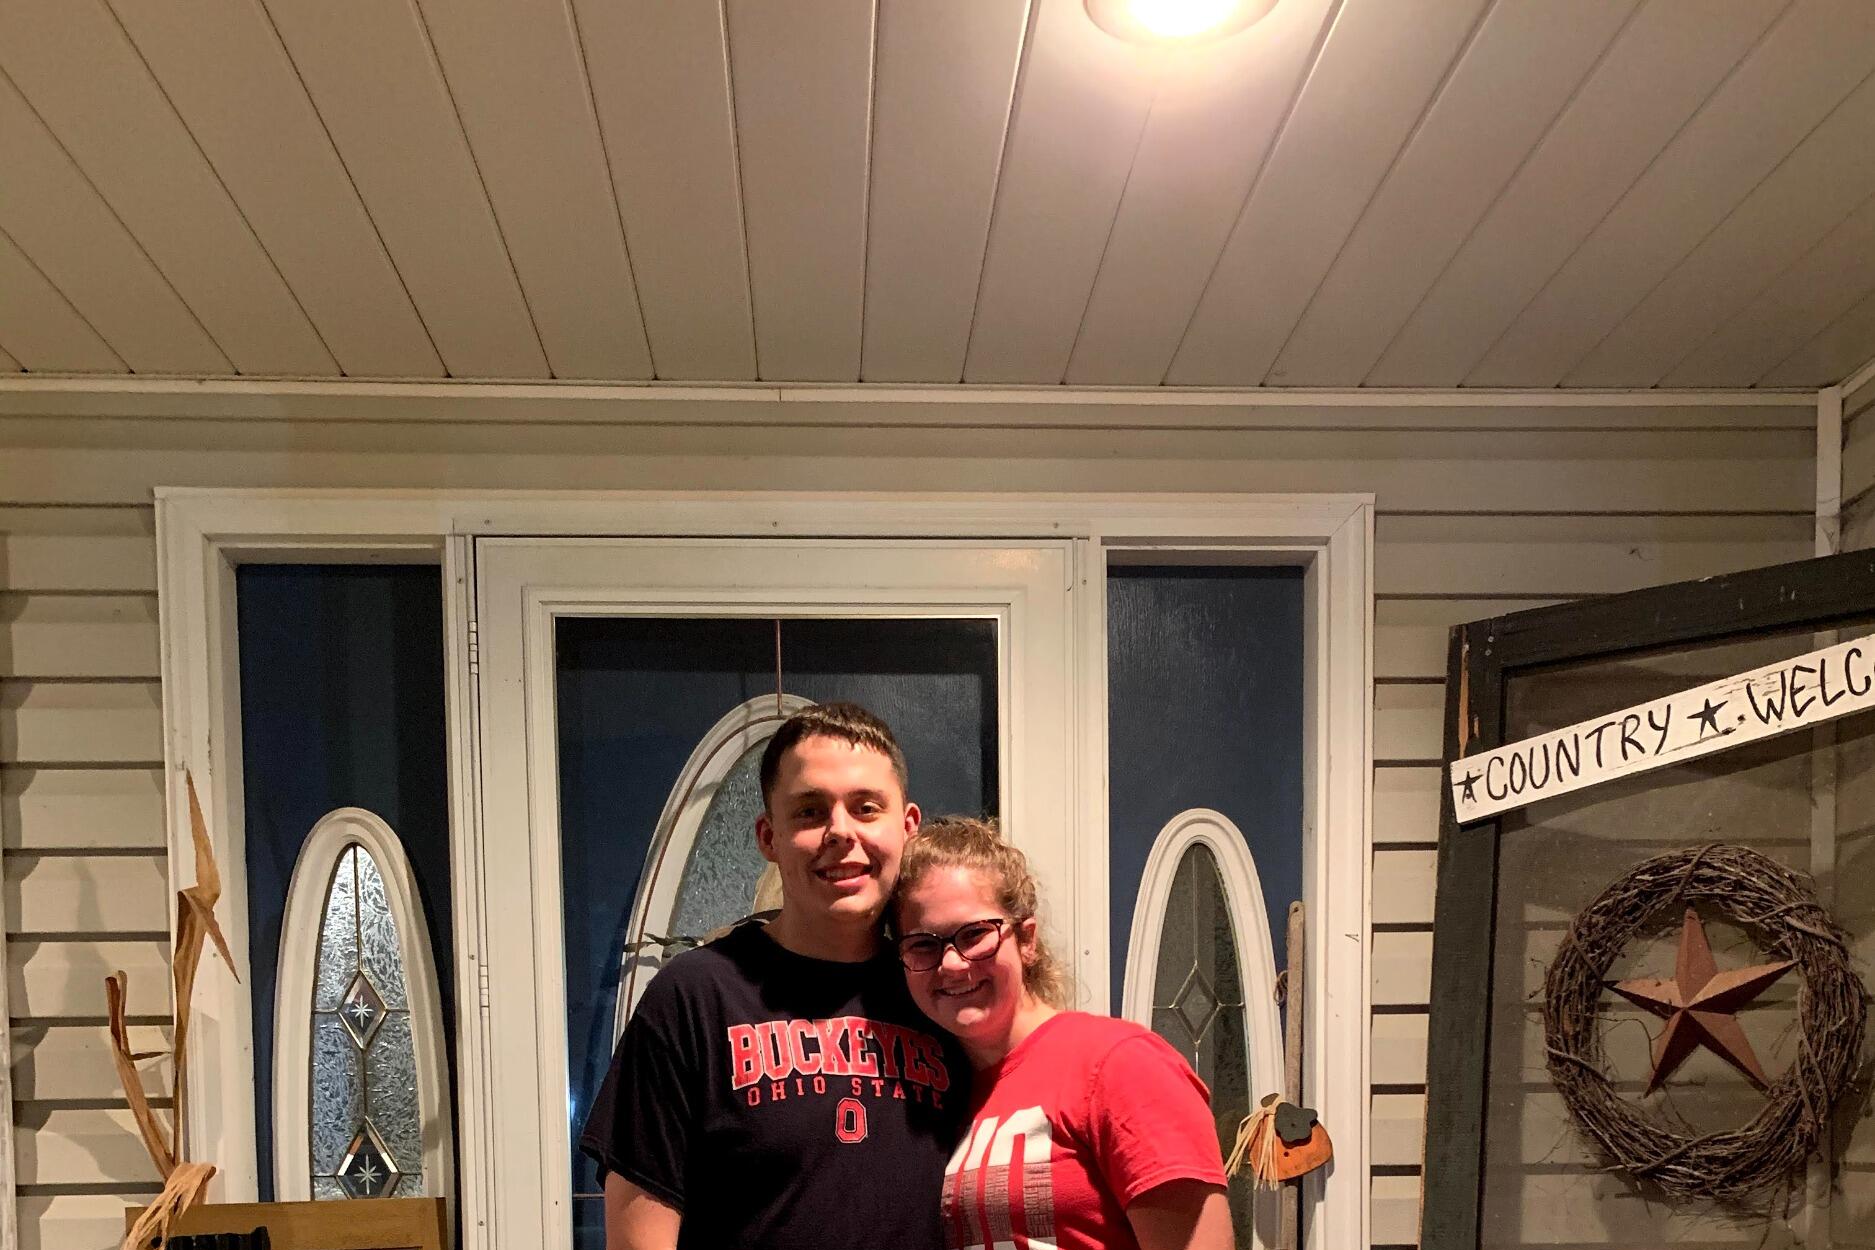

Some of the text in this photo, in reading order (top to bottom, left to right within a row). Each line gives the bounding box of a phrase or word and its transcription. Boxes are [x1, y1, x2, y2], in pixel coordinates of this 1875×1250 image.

[1486, 647, 1875, 801] COUNTRY WELC
[727, 1016, 950, 1091] BUCKEYES
[747, 1076, 944, 1109] OHIO STATE
